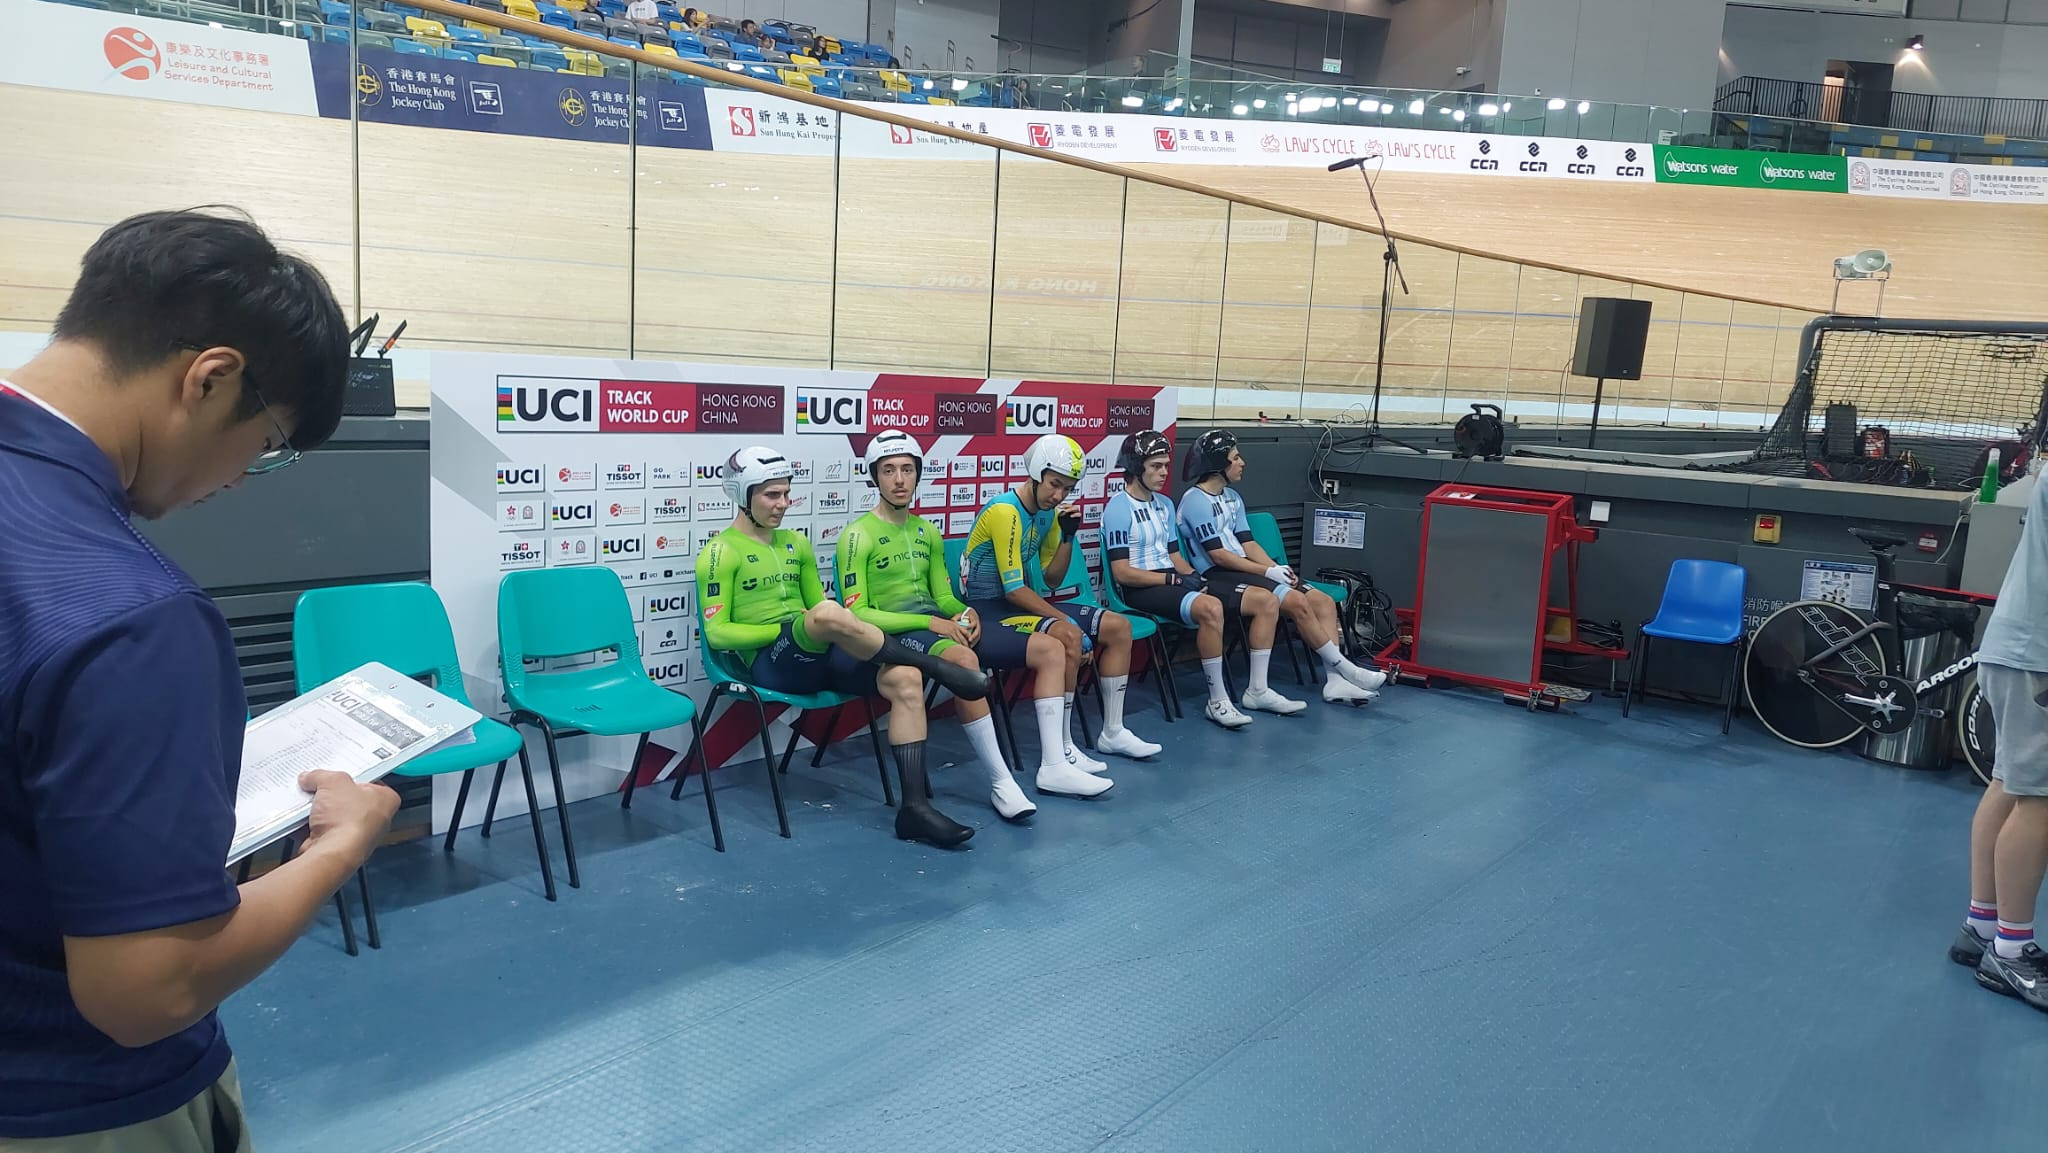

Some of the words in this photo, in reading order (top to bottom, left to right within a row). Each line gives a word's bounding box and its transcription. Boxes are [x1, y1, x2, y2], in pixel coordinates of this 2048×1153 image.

[168, 57, 206, 71] Leisure
[209, 65, 228, 74] and
[232, 66, 272, 79] Cultural
[164, 70, 209, 84] Services
[212, 76, 274, 91] Department
[388, 82, 406, 92] The
[408, 86, 432, 98] Hong
[433, 87, 456, 100] Kong
[392, 96, 422, 111] Jockey
[423, 99, 445, 111] Club
[592, 104, 606, 114] The
[608, 105, 628, 118] Hong
[594, 116, 619, 130] Jockey
[759, 110, 829, 128] 新鴻基地
[760, 128, 774, 137] Sun
[776, 129, 796, 140] Hung
[1284, 137, 1320, 154] LAW'S
[1322, 138, 1357, 154] CYCLE
[1388, 142, 1421, 158] LAW'S
[1424, 144, 1456, 160] CYCLE
[1667, 160, 1708, 174] Watsons
[1710, 164, 1739, 175] water
[1764, 166, 1805, 178] Watsons
[1808, 169, 1836, 180] water
[516, 388, 592, 422] UCI
[607, 390, 652, 405] TRACK
[702, 393, 740, 408] HONG
[742, 394, 776, 408] KONG
[872, 398, 904, 412] TRACK
[810, 397, 862, 425] UCI
[938, 401, 965, 412] HONG
[967, 402, 992, 413] KONG
[1060, 404, 1084, 414] TRACK
[1110, 406, 1130, 416] HONG
[1131, 406, 1150, 416] KONG
[608, 408, 660, 423] WORLD
[663, 410, 690, 424] CUP
[701, 410, 738, 424] CHINA
[872, 414, 908, 426] WORLD
[910, 414, 930, 427] CUP
[938, 416, 964, 427] CHINA
[1015, 403, 1054, 428] UCI
[1060, 417, 1087, 428] WORLD
[1088, 418, 1104, 428] CUP
[1109, 418, 1129, 428] CHINA
[986, 461, 1003, 472] UCI
[1090, 458, 1104, 468] UCI
[505, 469, 540, 484] UCI
[606, 472, 642, 481] TISSOT
[704, 466, 723, 479] UC
[654, 506, 687, 514] TISSOT
[820, 499, 846, 507] TISSOT
[560, 504, 592, 520] UCI
[1196, 522, 1216, 540] ARG
[610, 538, 640, 554] UCI
[501, 551, 541, 561] TISSOT
[657, 596, 685, 612] UCI
[656, 663, 683, 680] UCI
[332, 691, 361, 711] UCI
